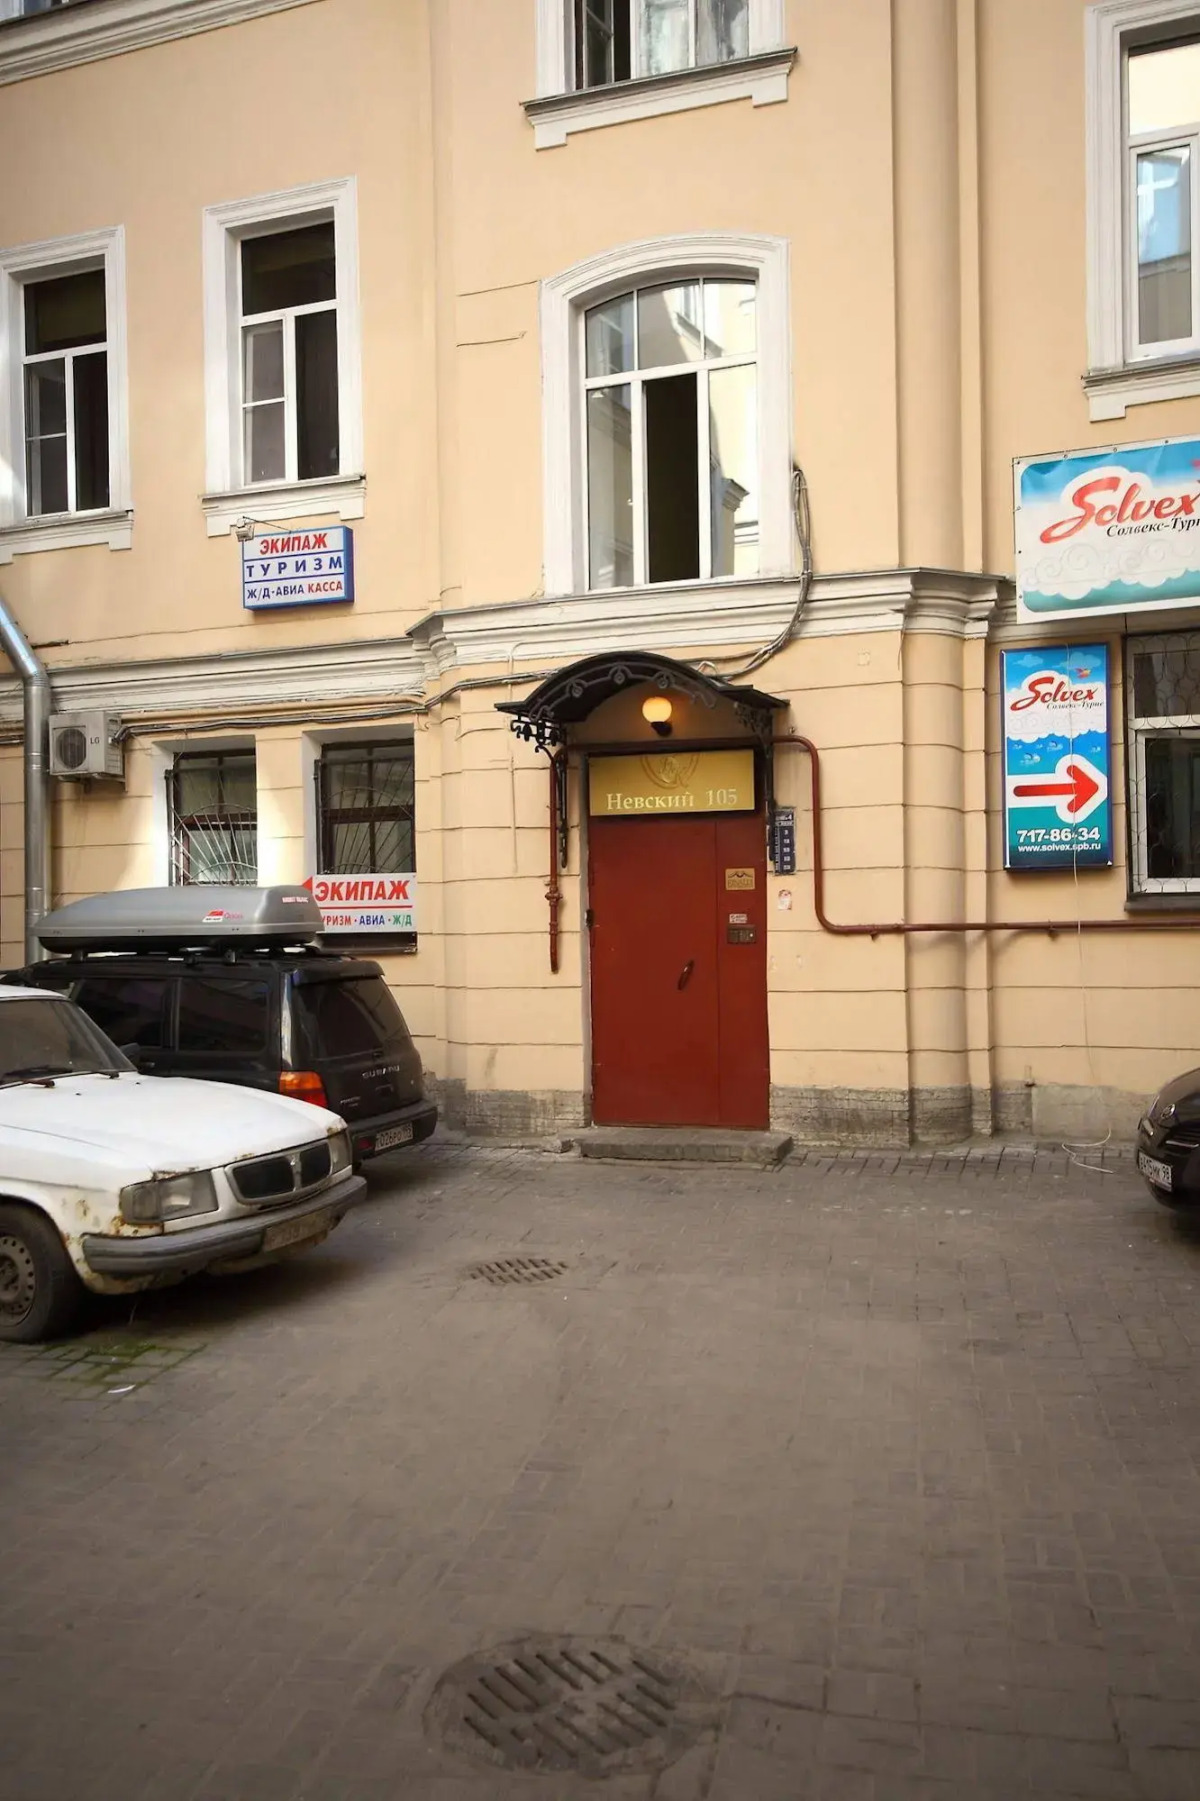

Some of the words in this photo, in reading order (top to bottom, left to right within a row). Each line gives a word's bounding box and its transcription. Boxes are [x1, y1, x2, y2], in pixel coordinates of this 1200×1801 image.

[1040, 476, 1200, 544] Solvex
[259, 532, 328, 555] ЭКИПАЖ
[246, 555, 343, 577] ТУРИЗМ
[307, 580, 343, 593] КАССА
[1010, 676, 1099, 712] Solvex
[90, 736, 99, 744] LG
[606, 791, 694, 810] Невский
[706, 788, 737, 806] 105
[1016, 827, 1101, 843] 717-86-34
[1018, 843, 1101, 852] www.solvex.spb.ru
[315, 880, 410, 902] ЭКИПАЖ
[359, 914, 385, 925] АВИА
[392, 914, 412, 927] Ж/Д
